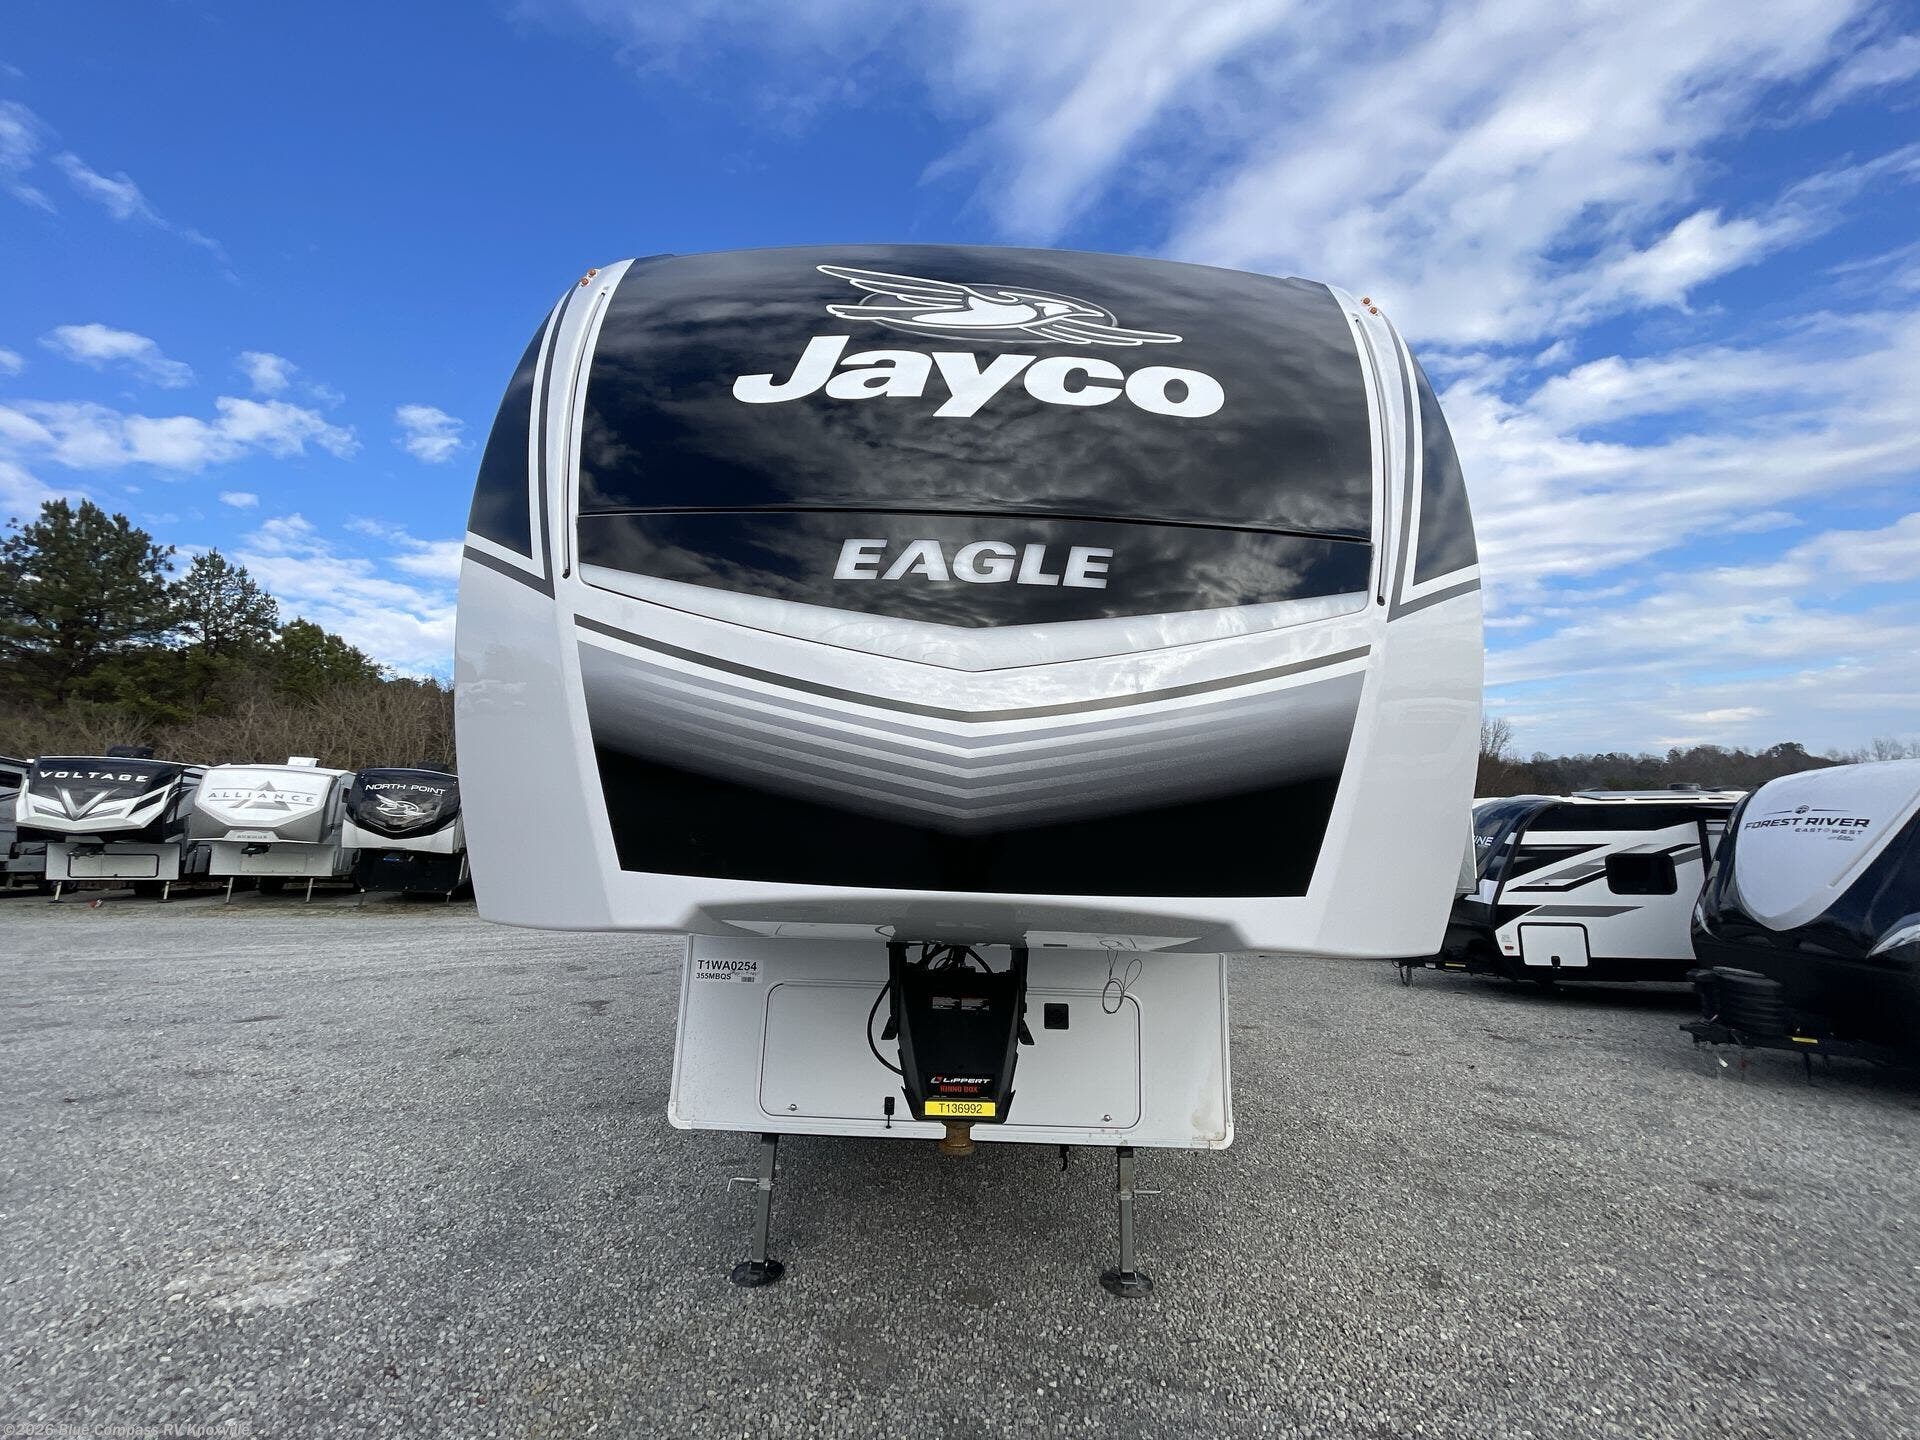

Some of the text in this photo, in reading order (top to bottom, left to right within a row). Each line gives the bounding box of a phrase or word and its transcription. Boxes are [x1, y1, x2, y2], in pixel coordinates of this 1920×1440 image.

[732, 335, 1225, 418] Jayco
[832, 538, 1113, 589] EAGLE
[40, 771, 149, 782] VOLTAGE
[365, 783, 446, 795] NORTH POINT
[208, 792, 314, 803] ALLIANCE
[1744, 817, 1870, 830] FOREST RIVER
[697, 959, 758, 971] T1WA0254
[695, 972, 732, 980] 355MBQS
[938, 1103, 983, 1114] T136992
